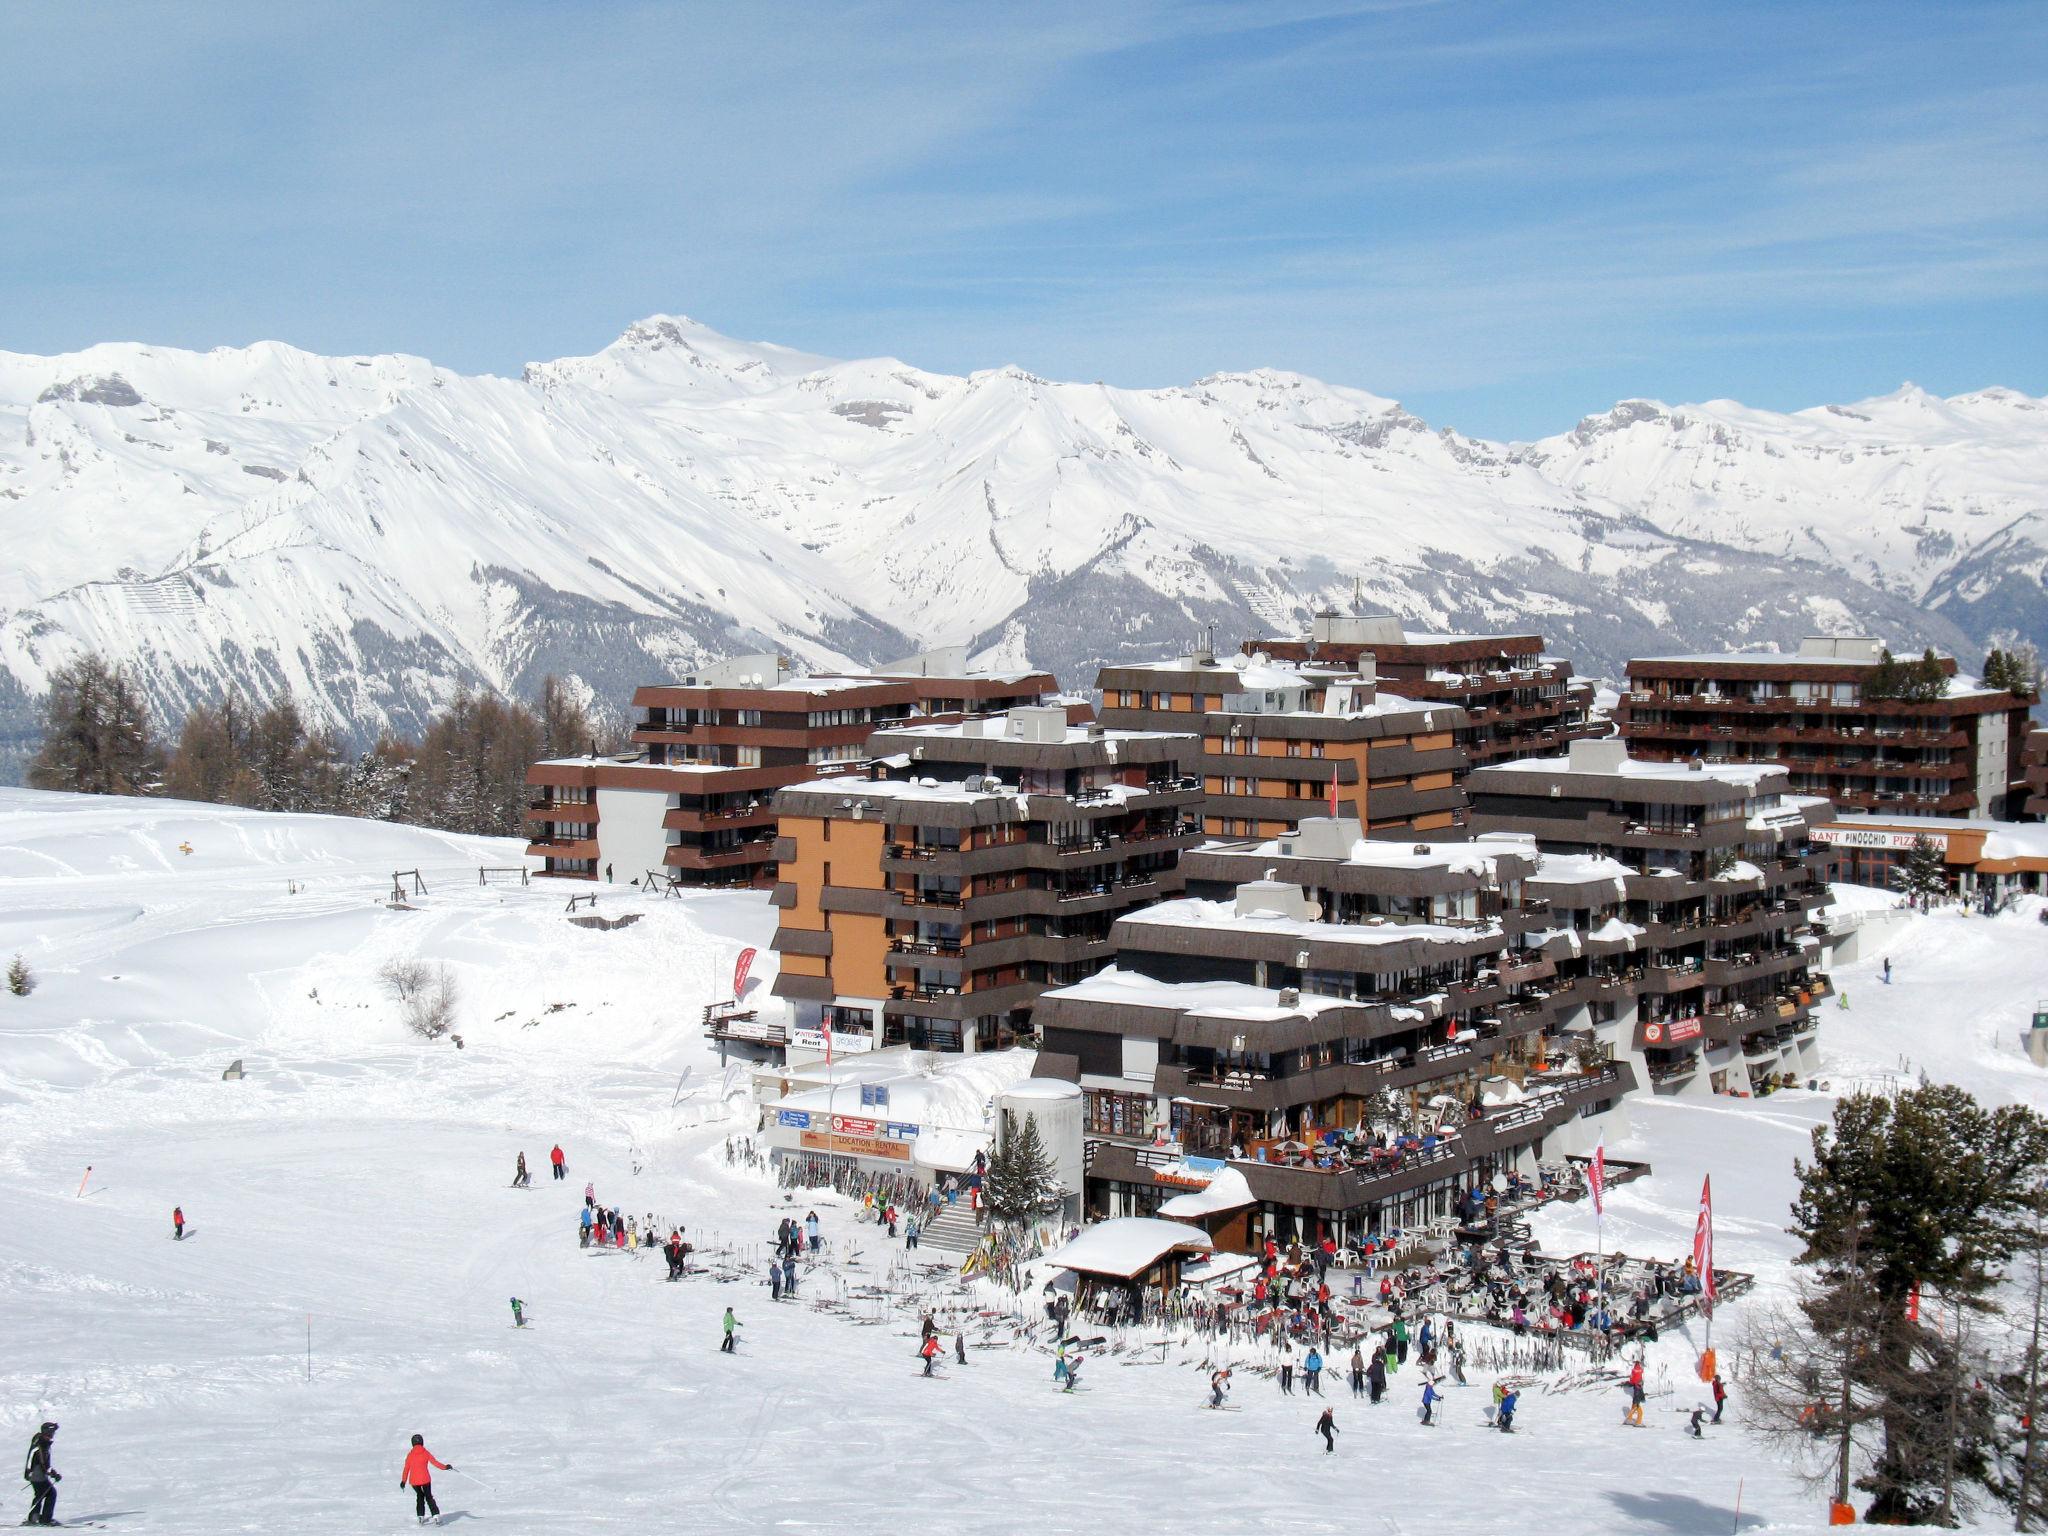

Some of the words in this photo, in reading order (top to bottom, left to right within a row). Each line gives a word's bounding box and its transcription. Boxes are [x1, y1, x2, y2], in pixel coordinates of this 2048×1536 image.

[1845, 832, 1886, 845] PINOCCHIO
[1893, 836, 1944, 848] PIZZIA
[802, 1039, 821, 1047] Rent
[839, 1137, 871, 1148] LOCATION
[876, 1141, 899, 1151] RENTAL
[1154, 1173, 1213, 1188] RESTAURAN
